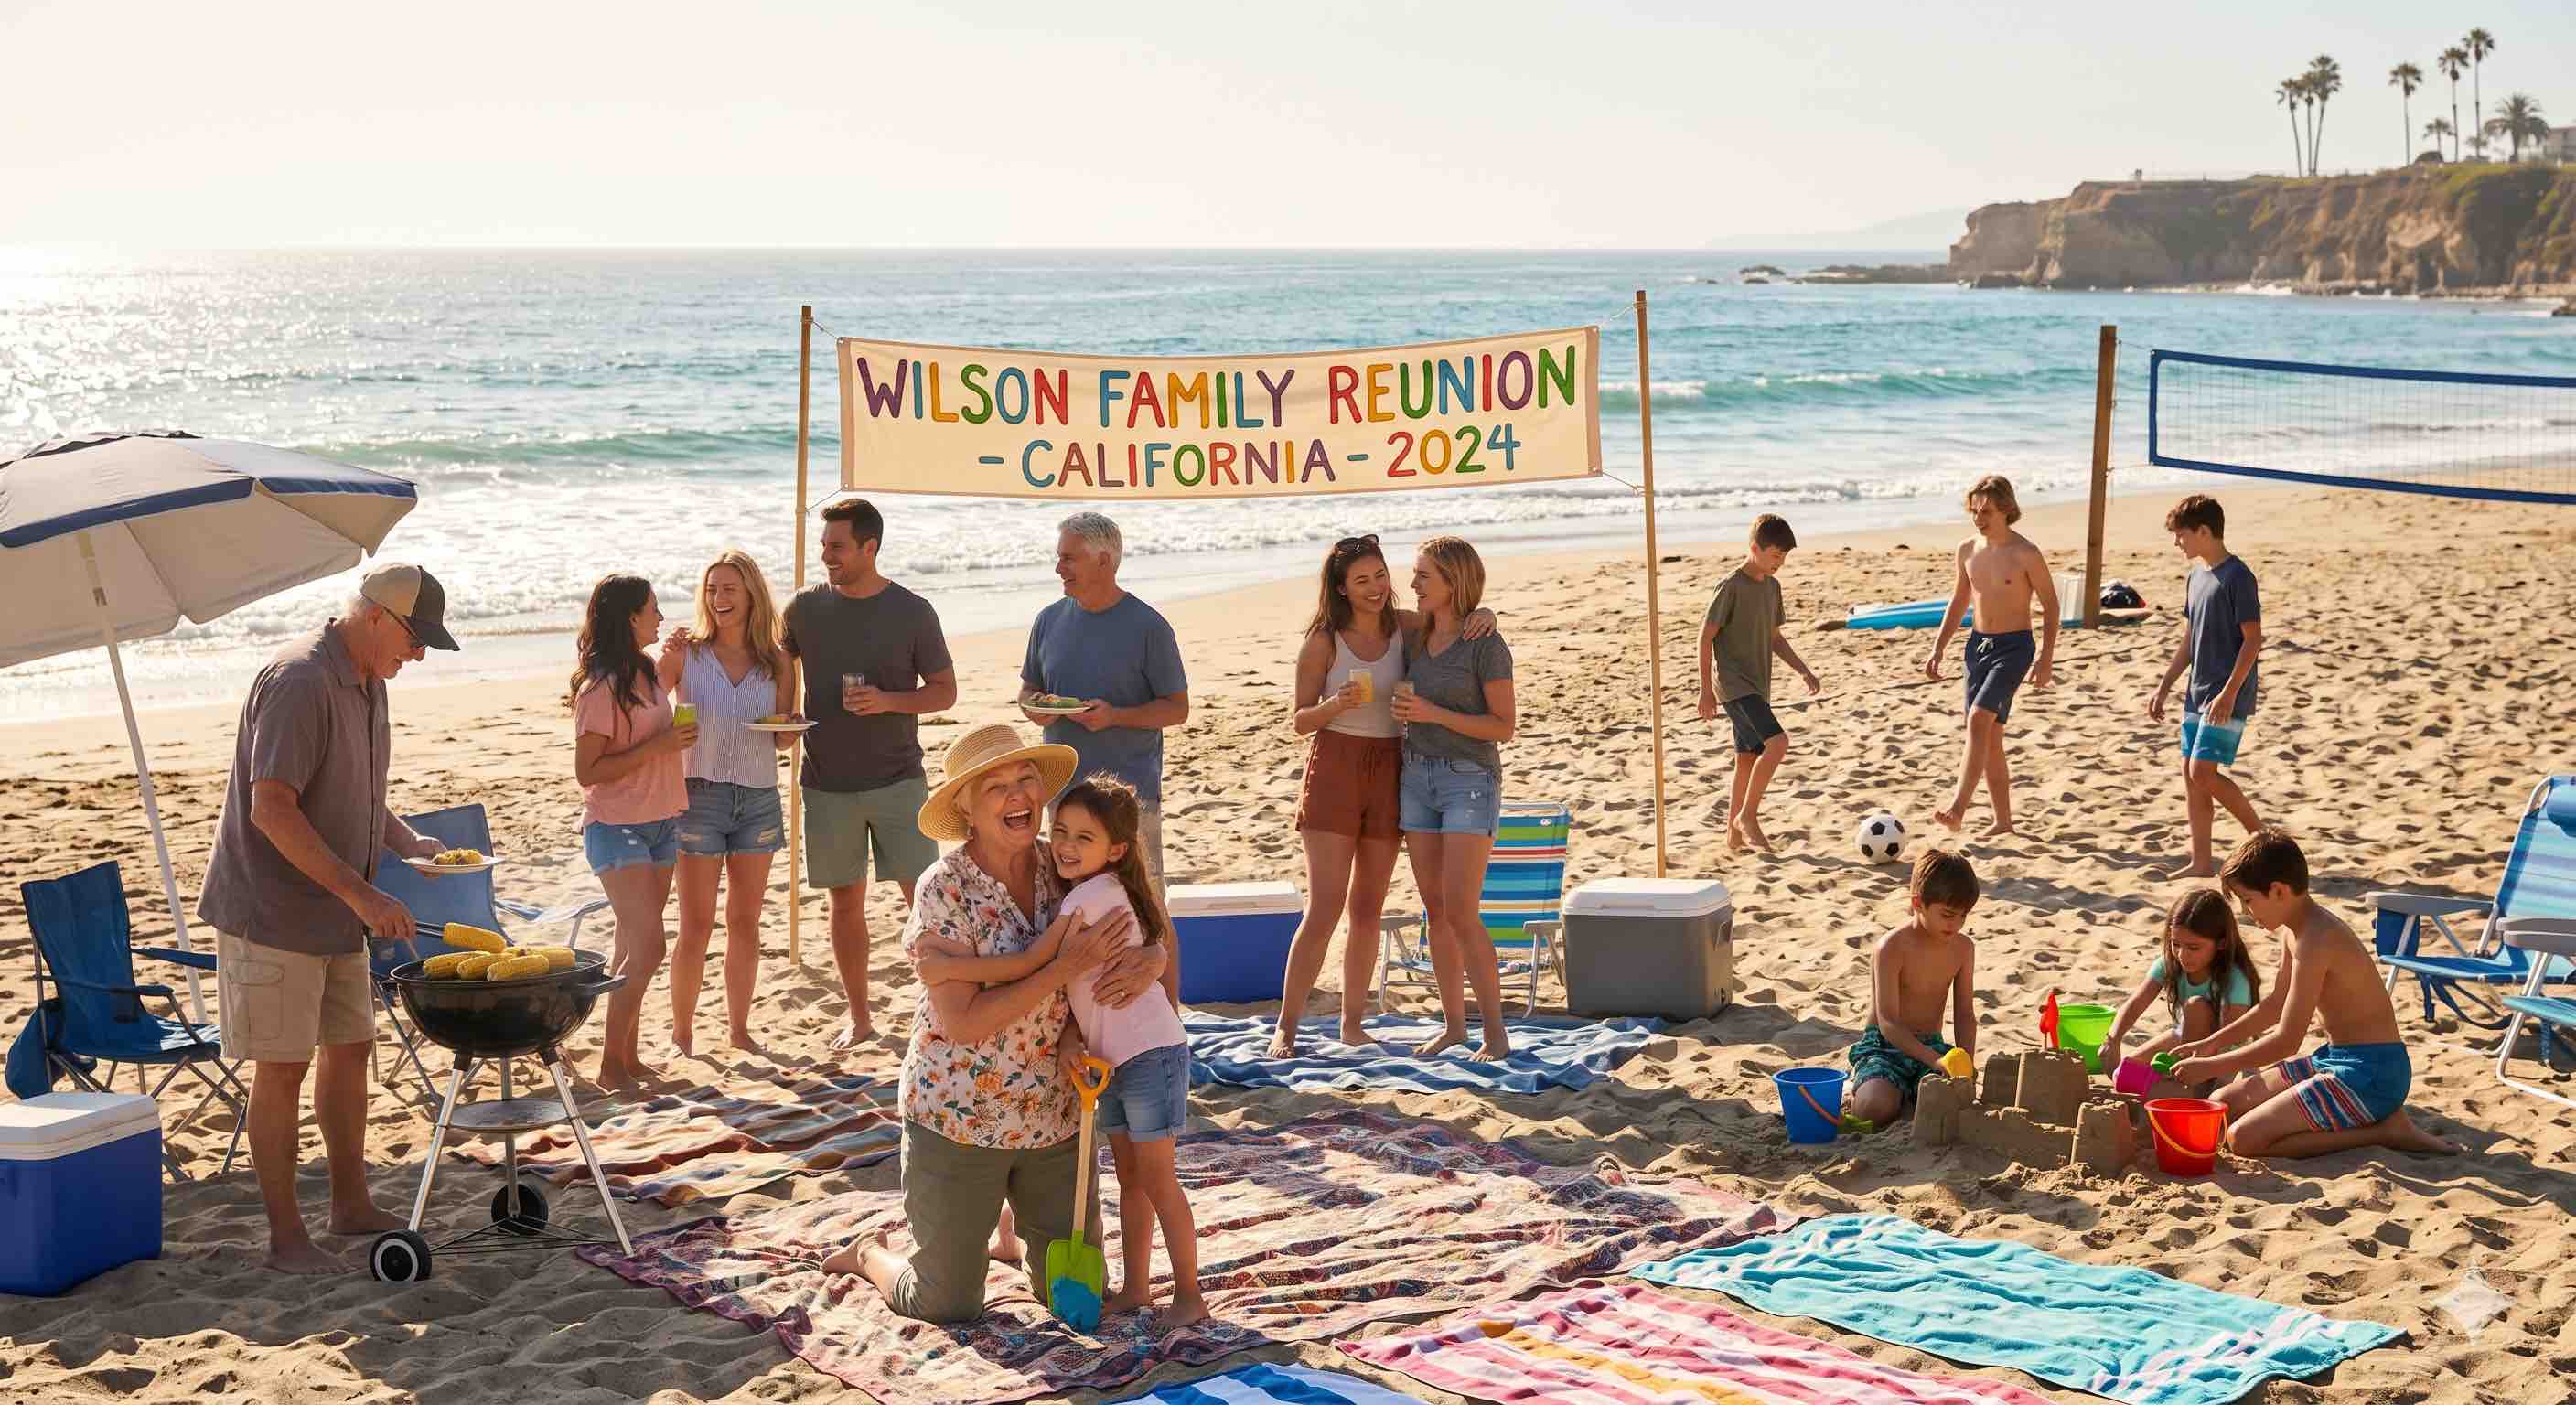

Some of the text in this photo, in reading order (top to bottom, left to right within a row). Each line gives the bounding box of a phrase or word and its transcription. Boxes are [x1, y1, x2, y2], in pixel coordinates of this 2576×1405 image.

[856, 344, 1576, 430] WILSON FAMILY REUNION
[1021, 438, 1336, 488] CALIFORNIA
[1386, 422, 1522, 478] 2024
